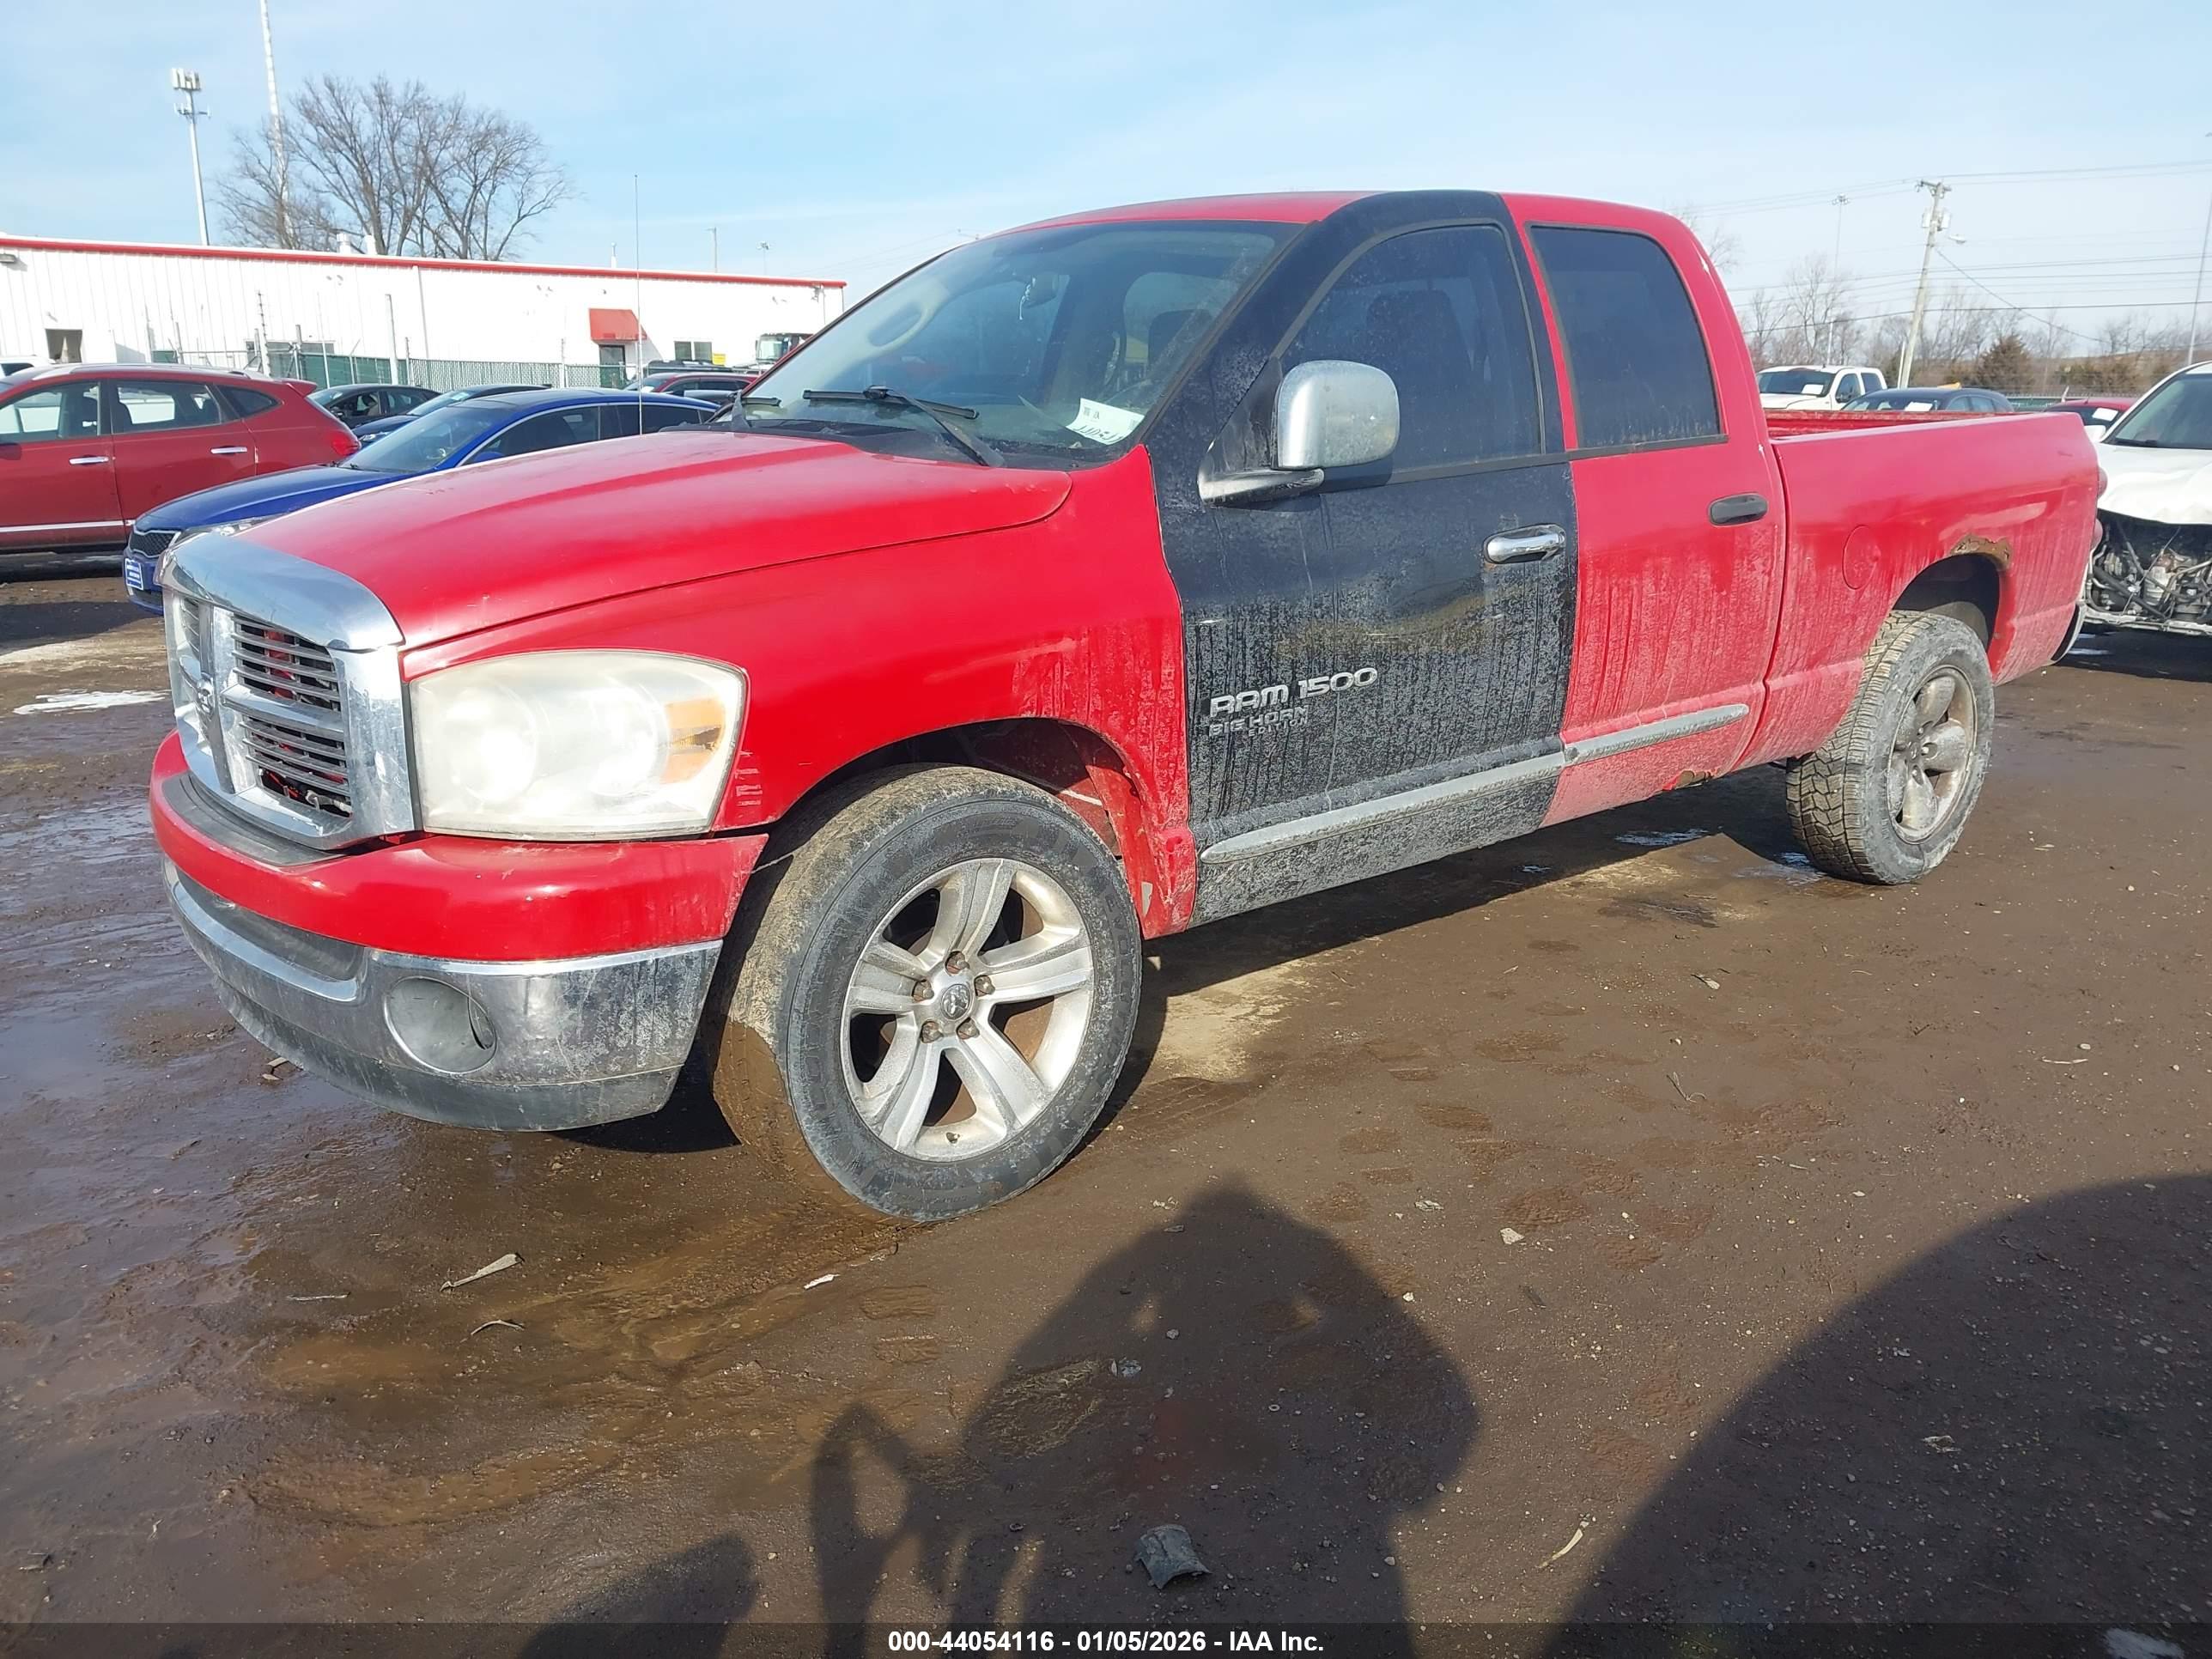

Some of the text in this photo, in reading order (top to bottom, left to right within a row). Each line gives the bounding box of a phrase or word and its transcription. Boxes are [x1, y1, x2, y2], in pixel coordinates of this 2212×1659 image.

[1209, 666, 1379, 719] RAM 1500
[1208, 704, 1310, 738] BIG HORN
[1247, 716, 1310, 738] EDITION
